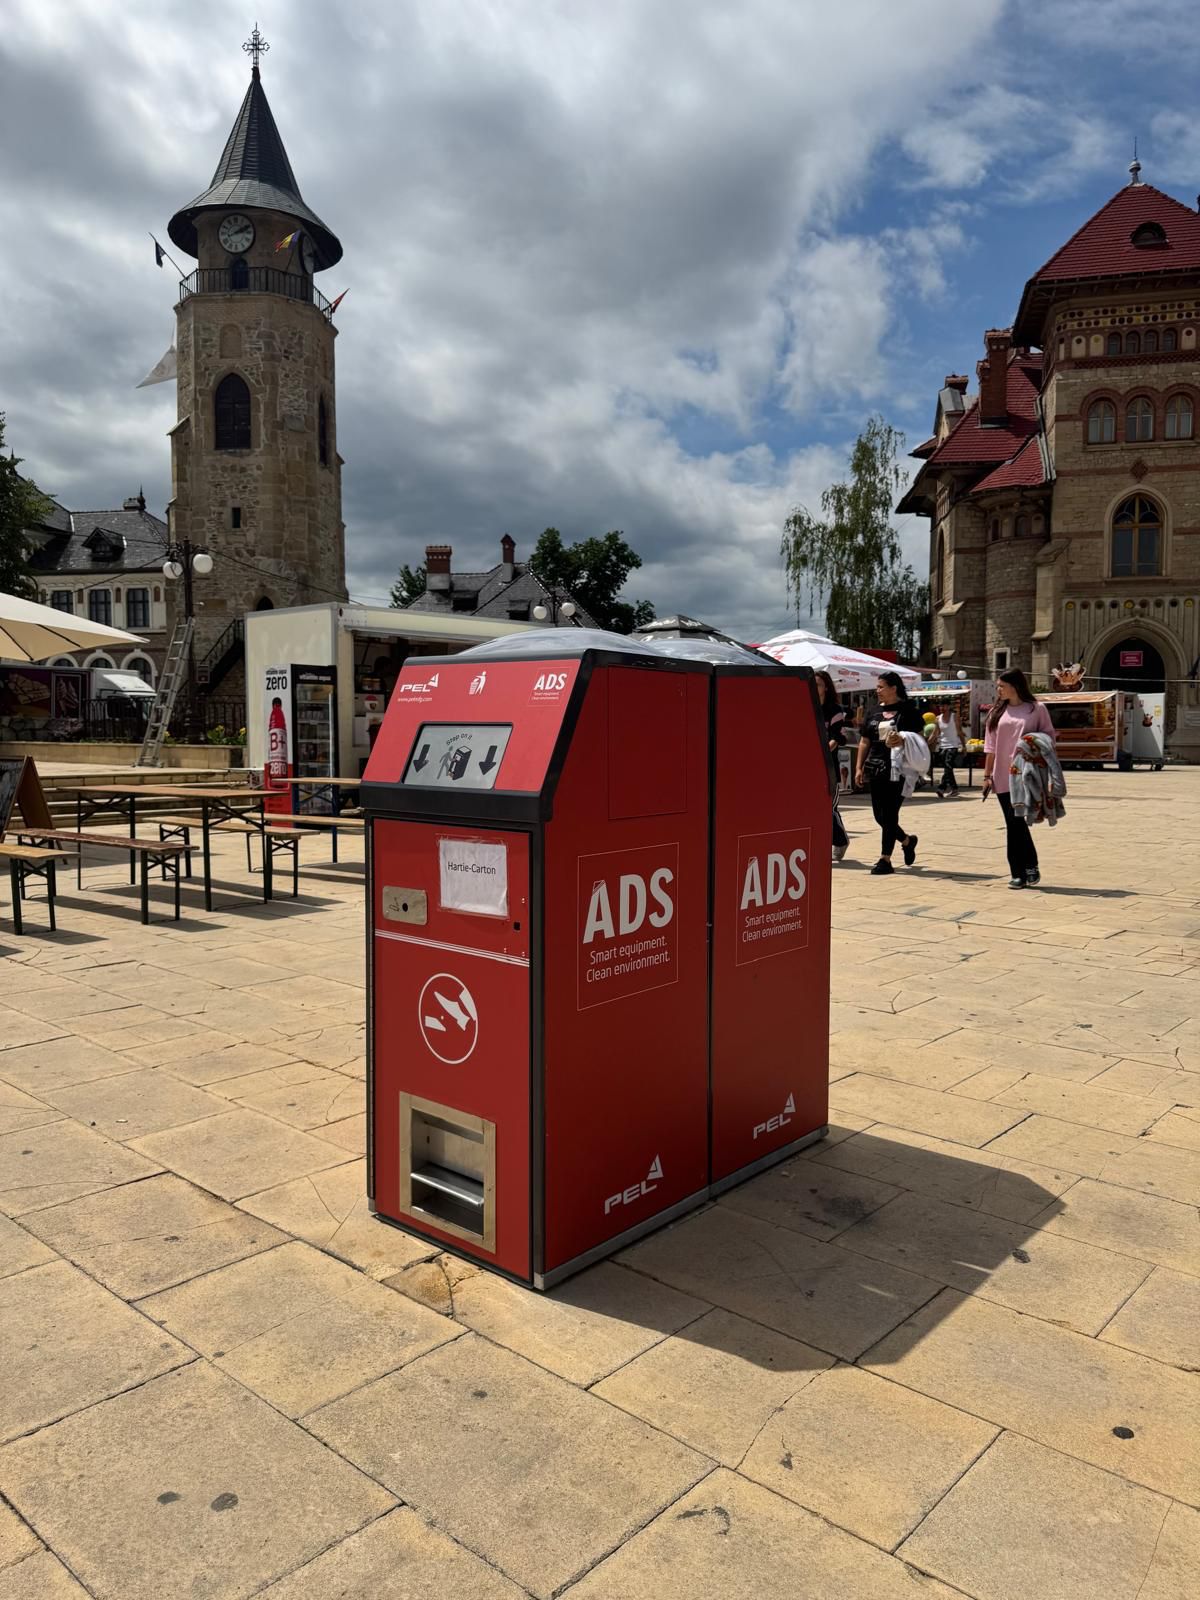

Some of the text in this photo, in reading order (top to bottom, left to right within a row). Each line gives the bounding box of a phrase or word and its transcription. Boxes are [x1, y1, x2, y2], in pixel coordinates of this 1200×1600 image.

[266, 676, 287, 690] zero
[534, 673, 567, 690] ADS
[270, 732, 286, 752] B+
[270, 761, 287, 775] zero
[447, 861, 496, 875] Hartie-Carton
[740, 848, 807, 910] ADS
[582, 867, 674, 944] ADS
[745, 914, 765, 928] Smart
[742, 930, 761, 943] Clean
[590, 935, 668, 965] Smart equipment.
[586, 951, 671, 983] Clean environment.
